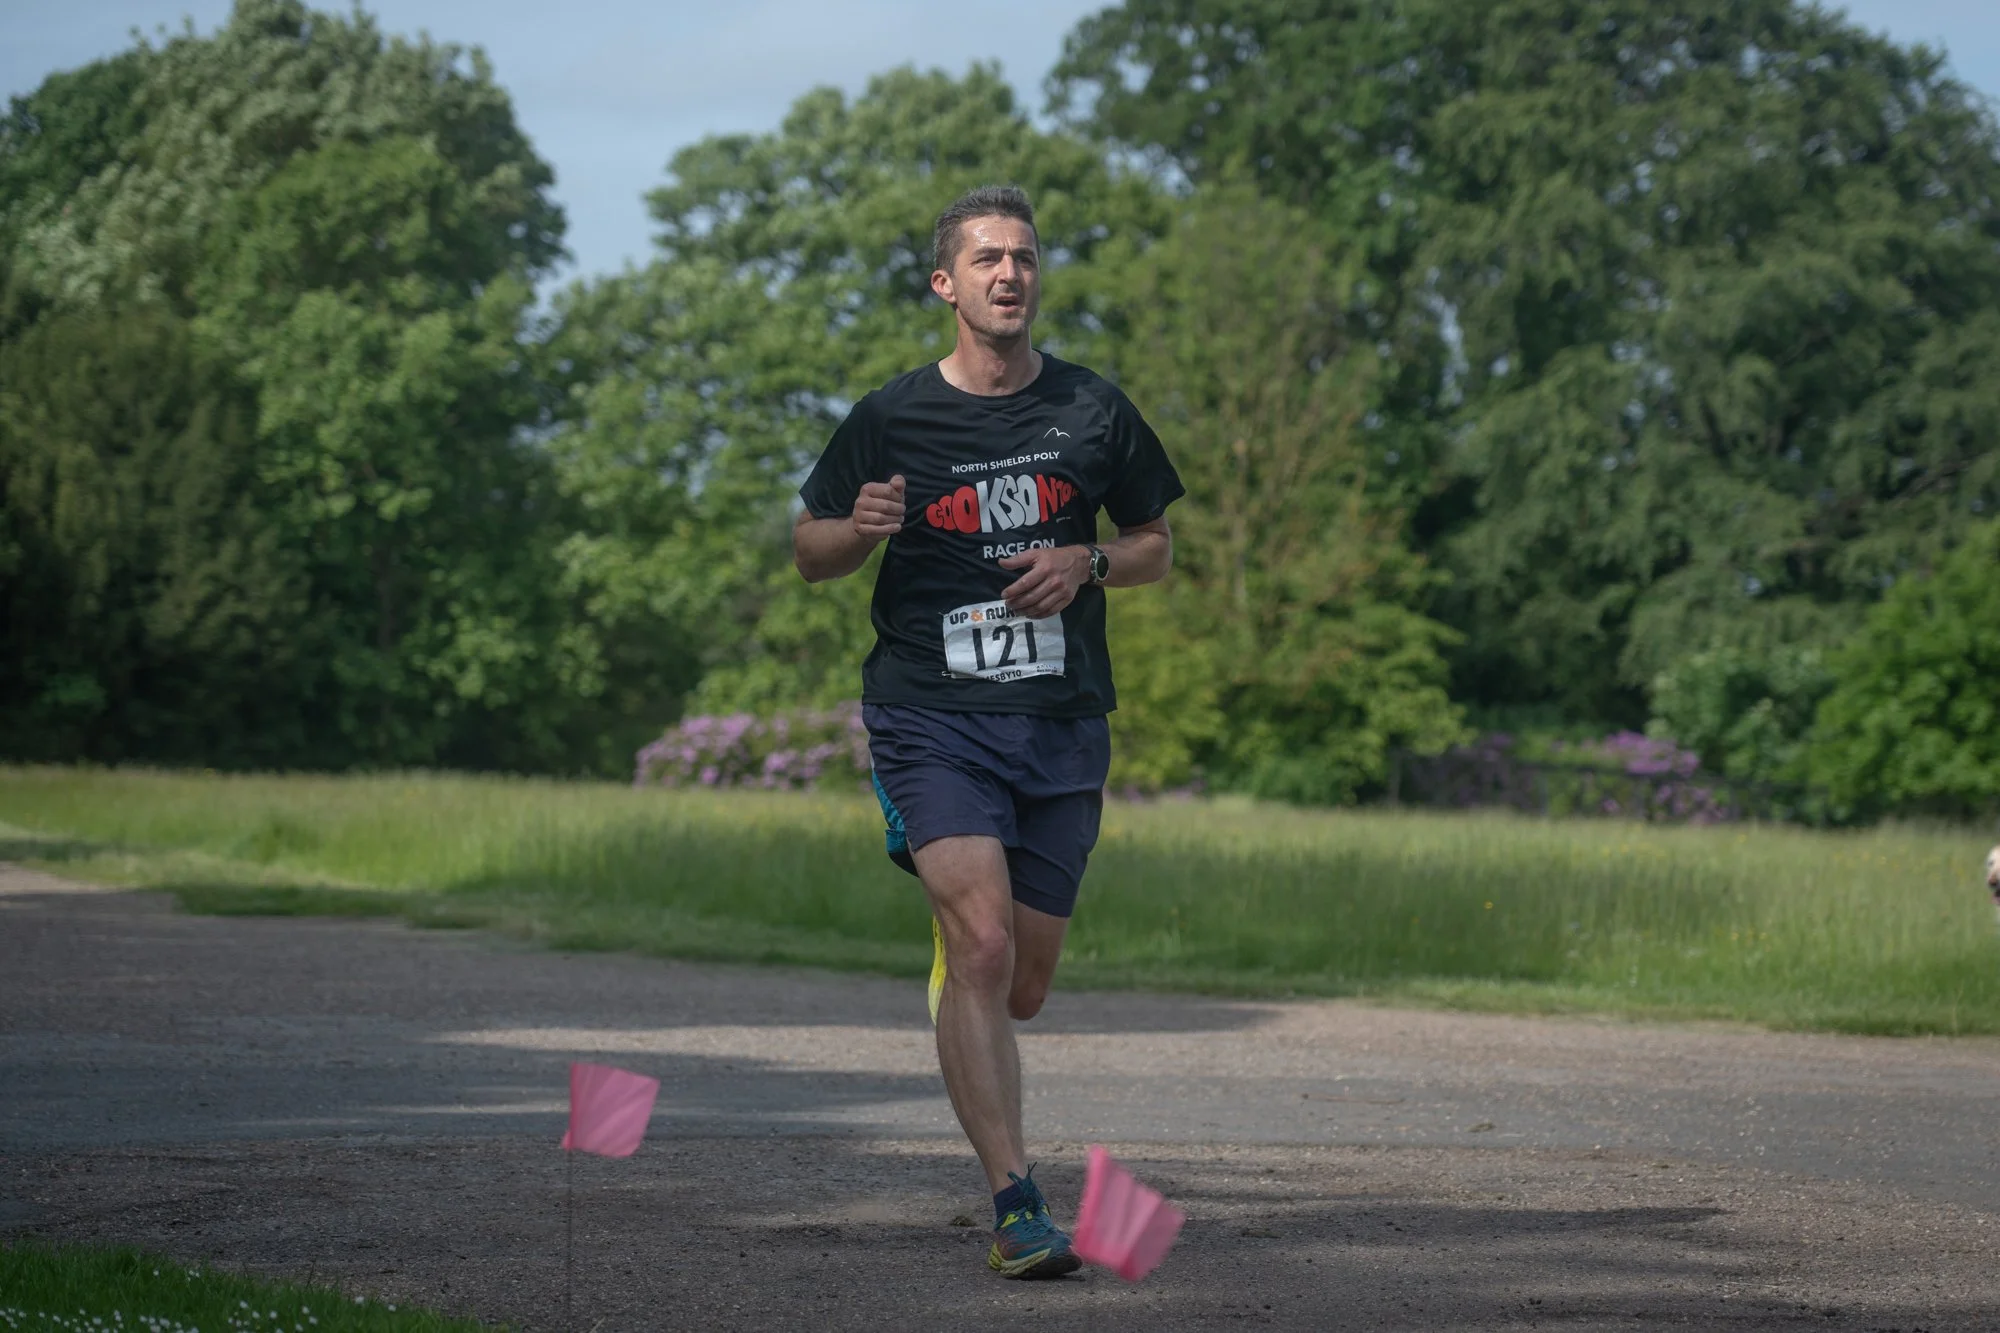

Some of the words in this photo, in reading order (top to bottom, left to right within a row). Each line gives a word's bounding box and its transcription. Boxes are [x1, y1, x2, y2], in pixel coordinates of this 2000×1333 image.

[951, 462, 988, 474] NORTH
[990, 455, 1032, 470] SHIELDS
[1034, 451, 1060, 463] POLY
[983, 541, 1025, 559] RACE
[1030, 538, 1055, 549] ON
[949, 611, 969, 625] UP
[971, 608, 984, 622] &
[972, 621, 1038, 671] 121
[986, 669, 1022, 682] ESBY10
